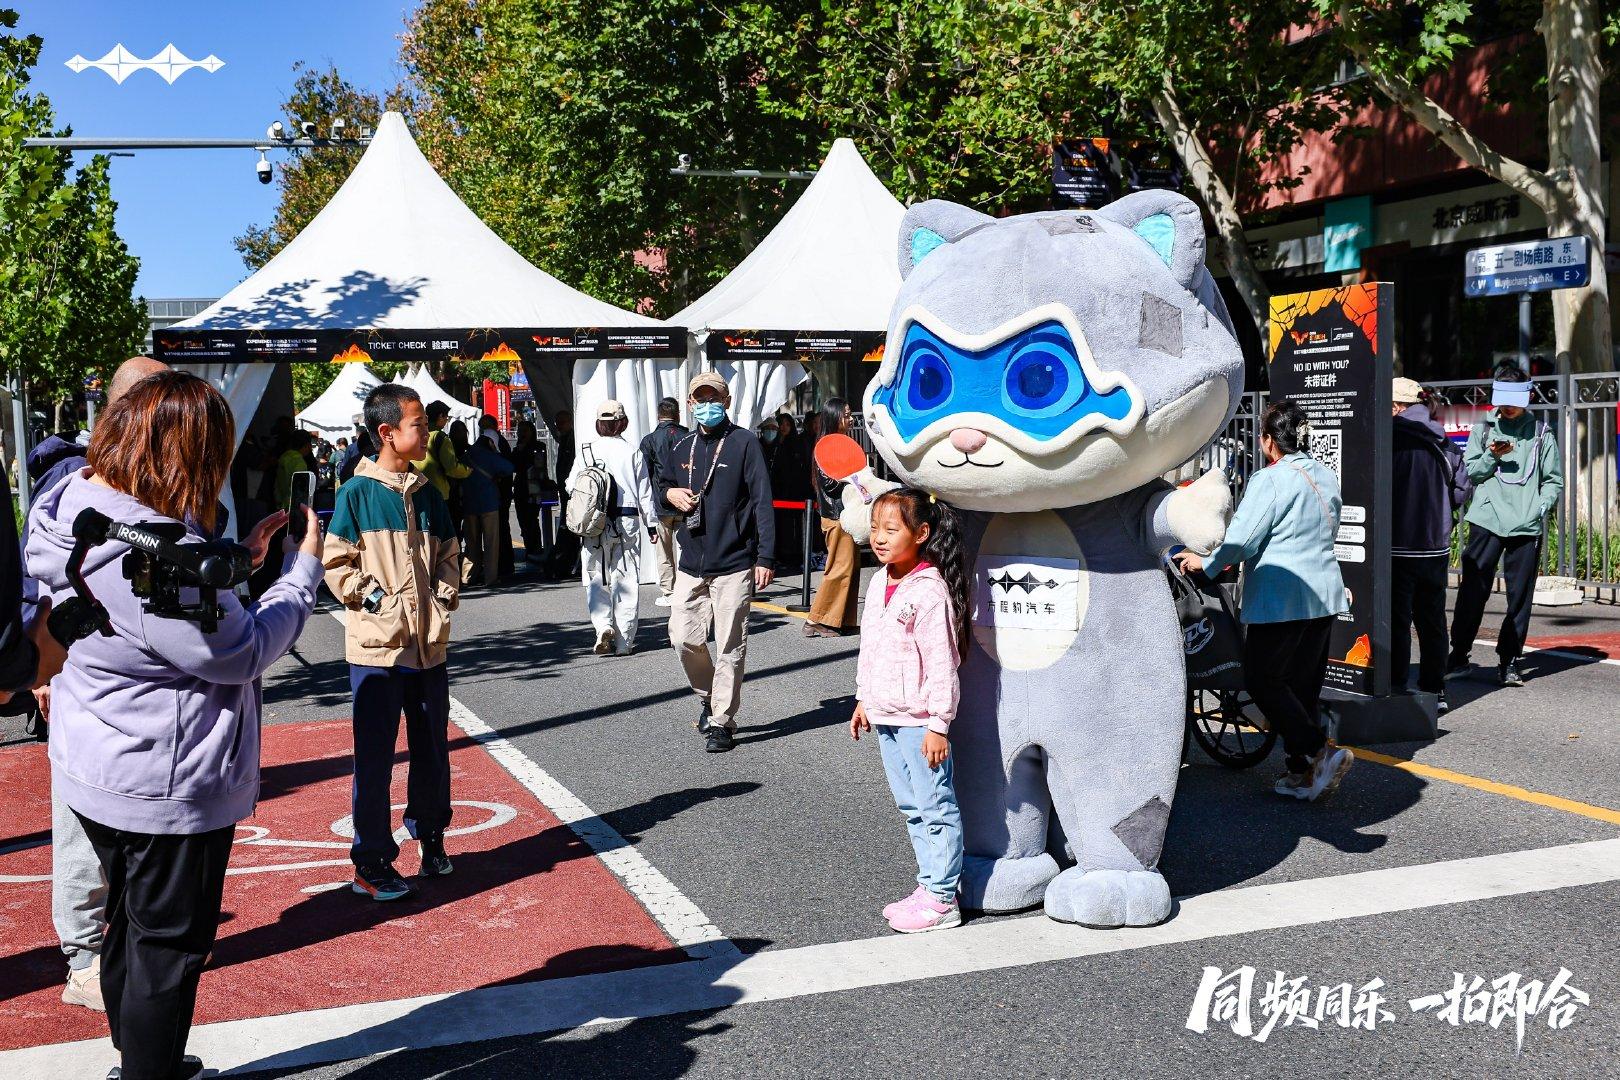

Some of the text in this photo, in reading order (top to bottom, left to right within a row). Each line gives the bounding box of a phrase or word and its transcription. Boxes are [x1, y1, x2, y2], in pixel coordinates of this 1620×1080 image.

[1562, 242, 1572, 254] 东
[1494, 245, 1554, 268] 五一剧场南路
[1558, 256, 1576, 264] 453m
[1528, 274, 1544, 284] South
[1545, 272, 1554, 282] Rd
[1564, 270, 1570, 280] E
[1478, 280, 1486, 290] W
[368, 341, 396, 349] TICKET
[432, 340, 459, 350] 验票口
[1294, 360, 1349, 372] NO ID WITH YOU?
[1304, 372, 1337, 388] 未带证件
[120, 527, 160, 548] RONIN
